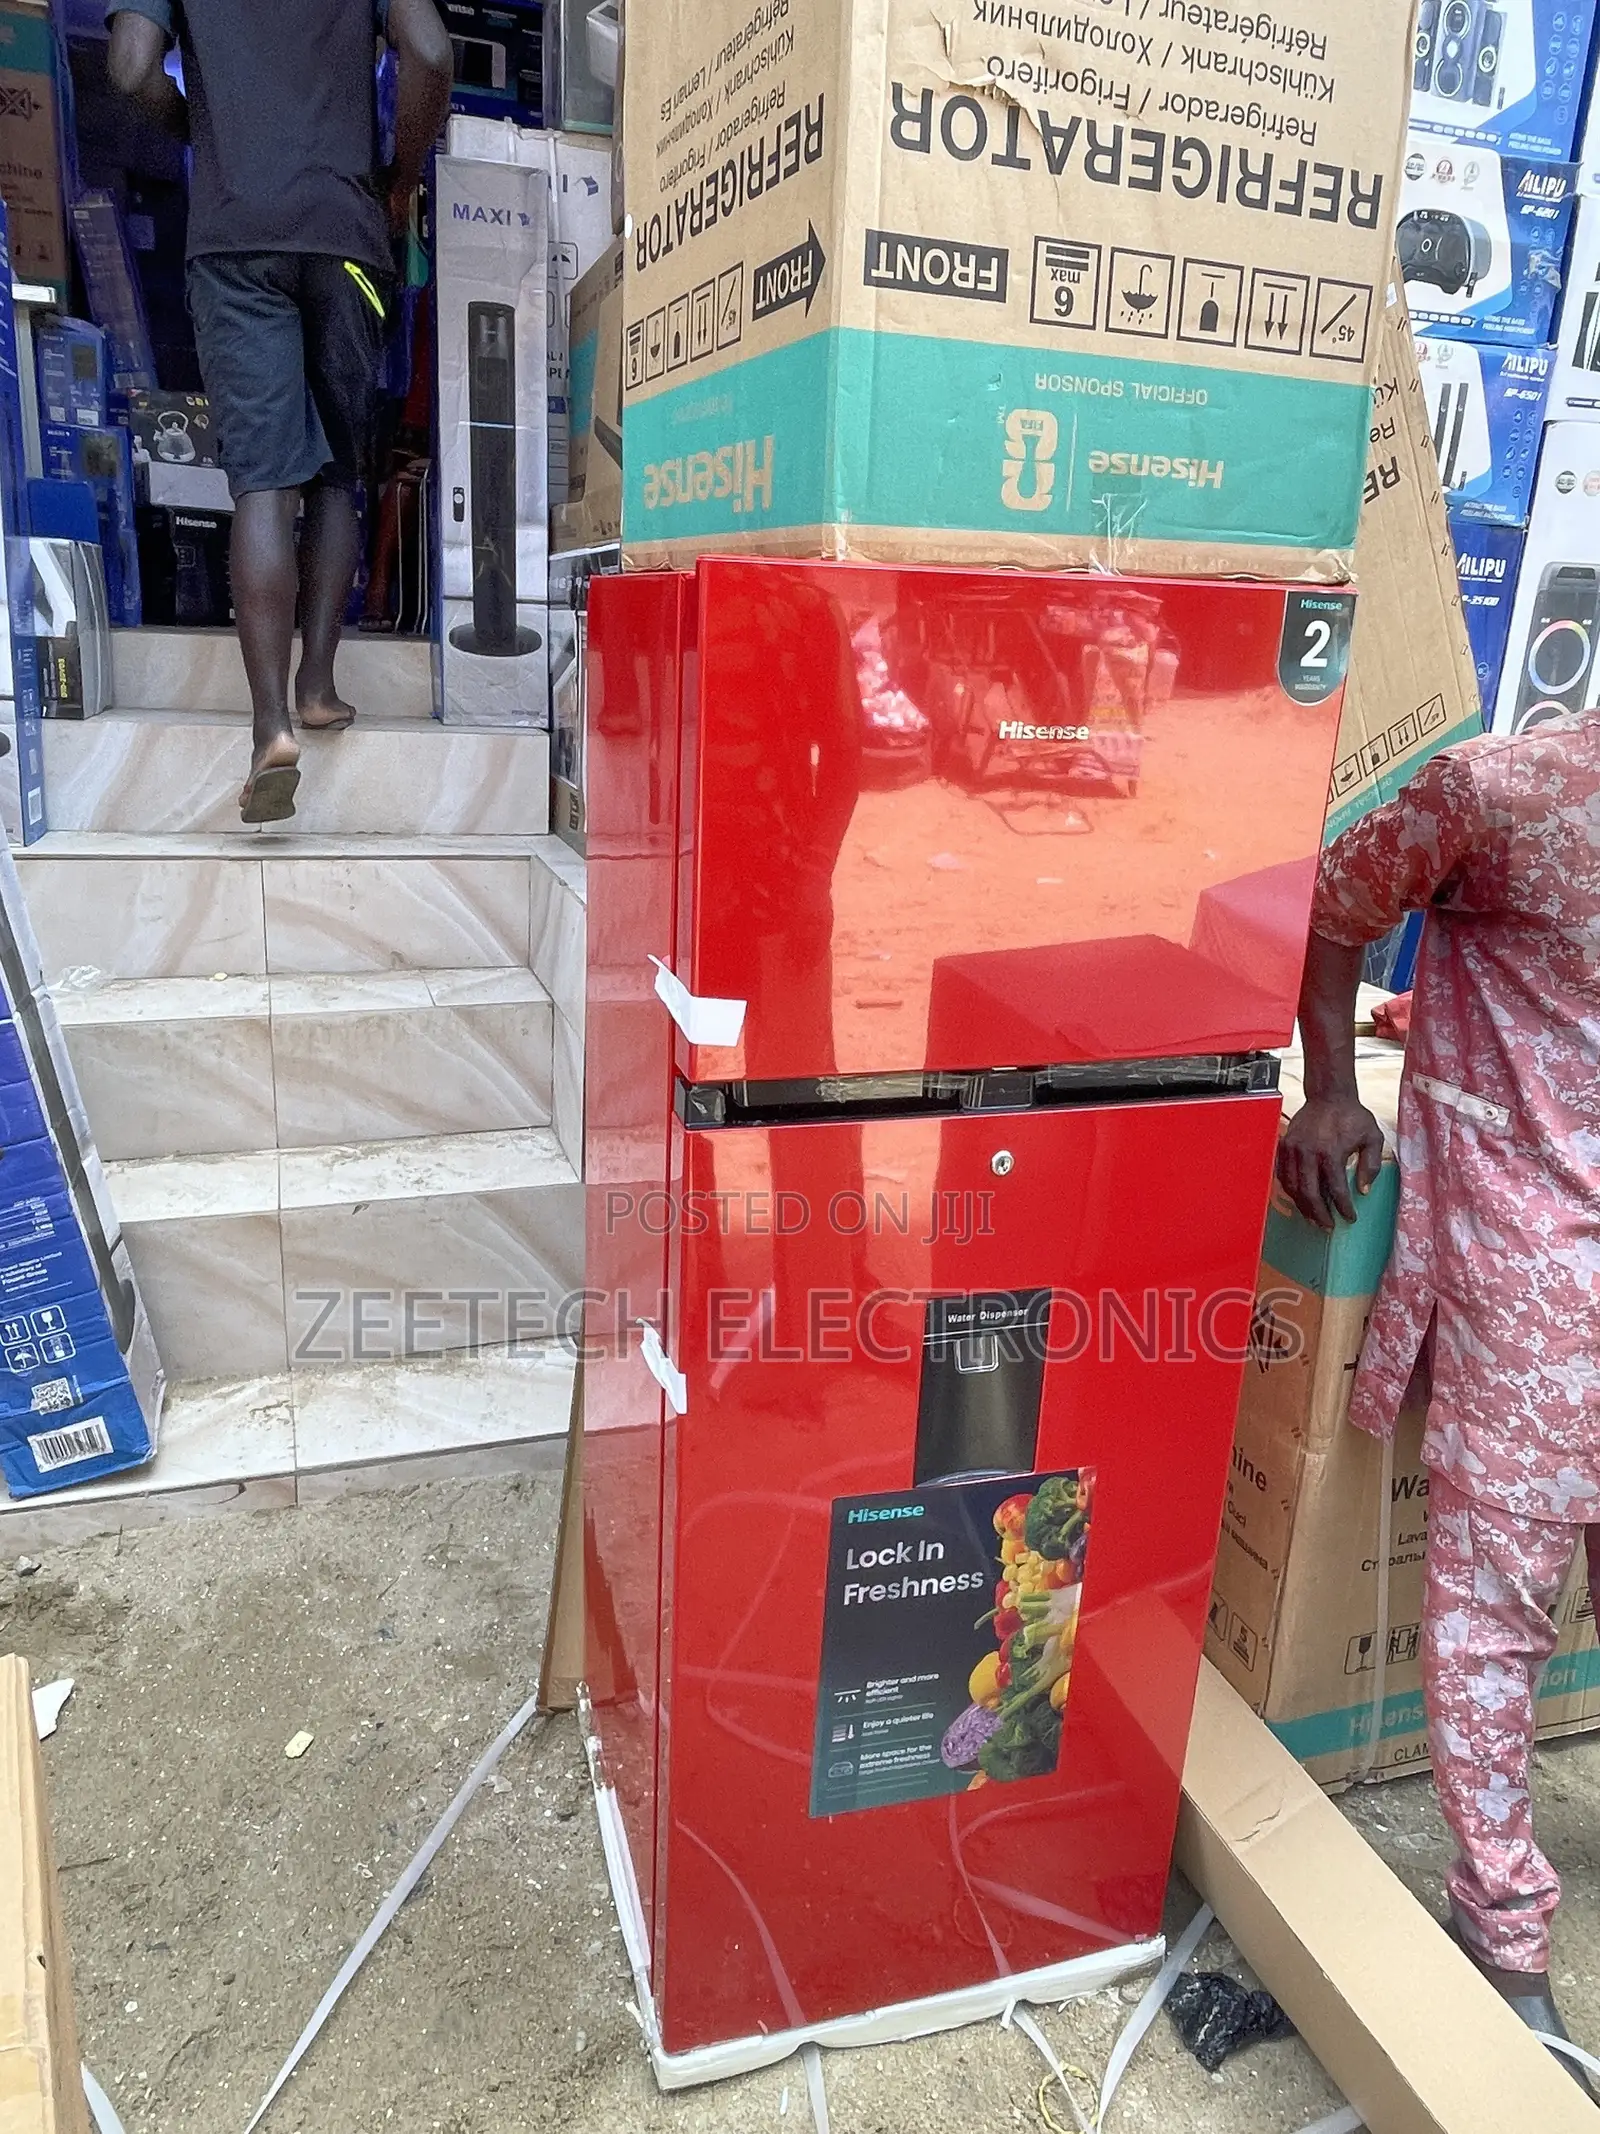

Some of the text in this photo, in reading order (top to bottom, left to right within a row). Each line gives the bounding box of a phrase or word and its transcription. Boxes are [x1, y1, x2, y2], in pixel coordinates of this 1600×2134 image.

[973, 0, 1154, 67] Холодильник
[1159, 0, 1328, 61] Réfrigérateur
[724, 25, 795, 104] Kühlschrank
[1181, 45, 1335, 104] Kühlschrank
[987, 56, 1131, 111] Frigorifero
[715, 81, 786, 151] Refrigerador
[1159, 91, 1318, 147] Refrigerador
[890, 81, 1383, 230] REFRIGERATOR
[636, 92, 825, 272] REFRIGERATOR
[1518, 170, 1567, 198] AILIPU
[453, 202, 511, 226] MAXI
[755, 249, 813, 310] FRONT
[871, 242, 999, 293] FRONT
[1050, 268, 1080, 285] max
[1053, 286, 1074, 317] 6
[1502, 351, 1549, 376] AILIPU
[1035, 372, 1208, 406] OFFICIAL SPONSOR
[643, 434, 774, 513] Hisense
[1089, 450, 1225, 489] Hisense
[176, 516, 217, 529] Hisense
[1456, 552, 1507, 578] AILIPU
[1300, 599, 1343, 611] Hisense
[1300, 620, 1331, 668] 2
[999, 721, 1090, 740] Hisense
[948, 1313, 975, 1324] Water
[847, 1504, 925, 1524] Hisense
[846, 1540, 945, 1571] Lock In
[843, 1570, 985, 1606] Freshness
[900, 1675, 917, 1684] and
[863, 1720, 885, 1729] Enjoy
